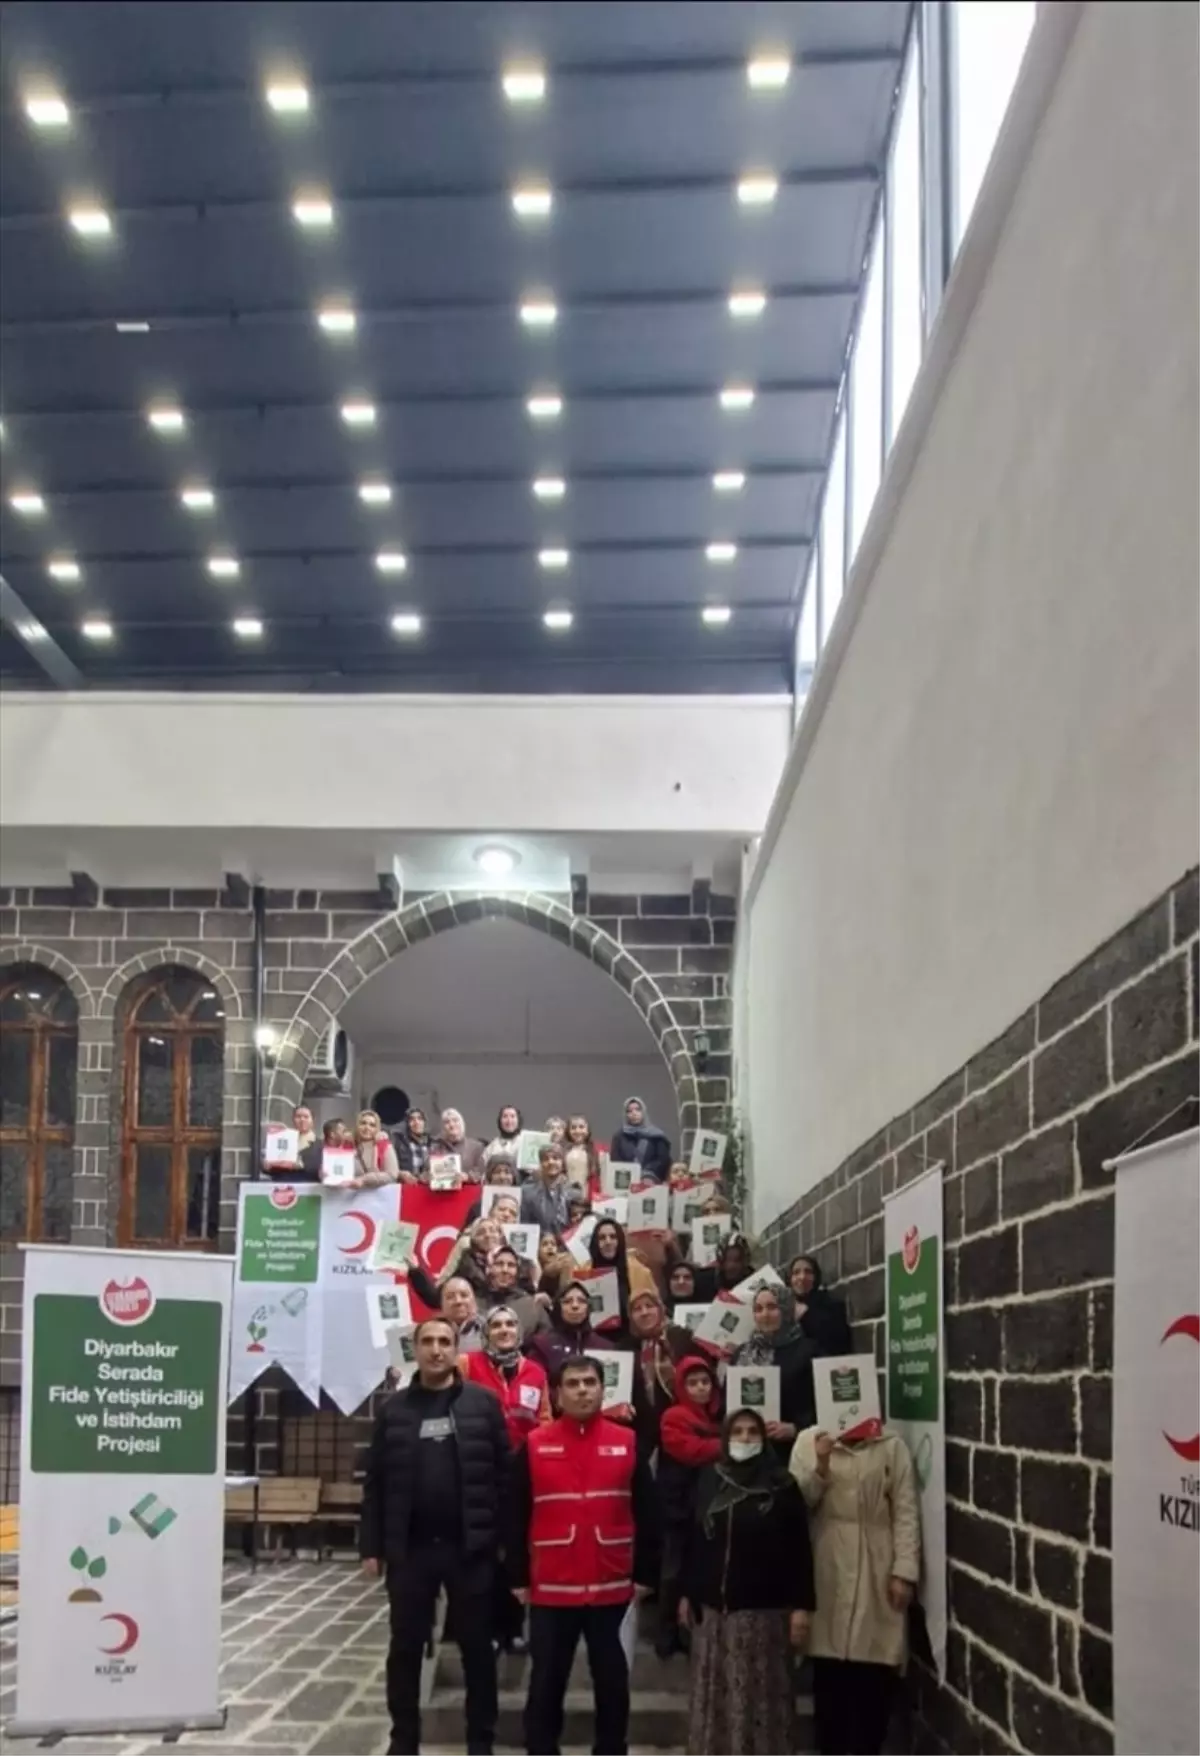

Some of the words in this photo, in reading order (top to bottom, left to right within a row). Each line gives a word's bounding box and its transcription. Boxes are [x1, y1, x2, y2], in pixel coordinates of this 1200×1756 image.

[84, 1338, 179, 1359] Diyarbakır
[97, 1362, 164, 1381] Serada
[48, 1385, 90, 1404] Fide
[93, 1386, 204, 1410] Yetiştiriciliği
[75, 1413, 98, 1428] ve
[102, 1408, 182, 1430] İstihdam
[96, 1434, 161, 1456] Projesi
